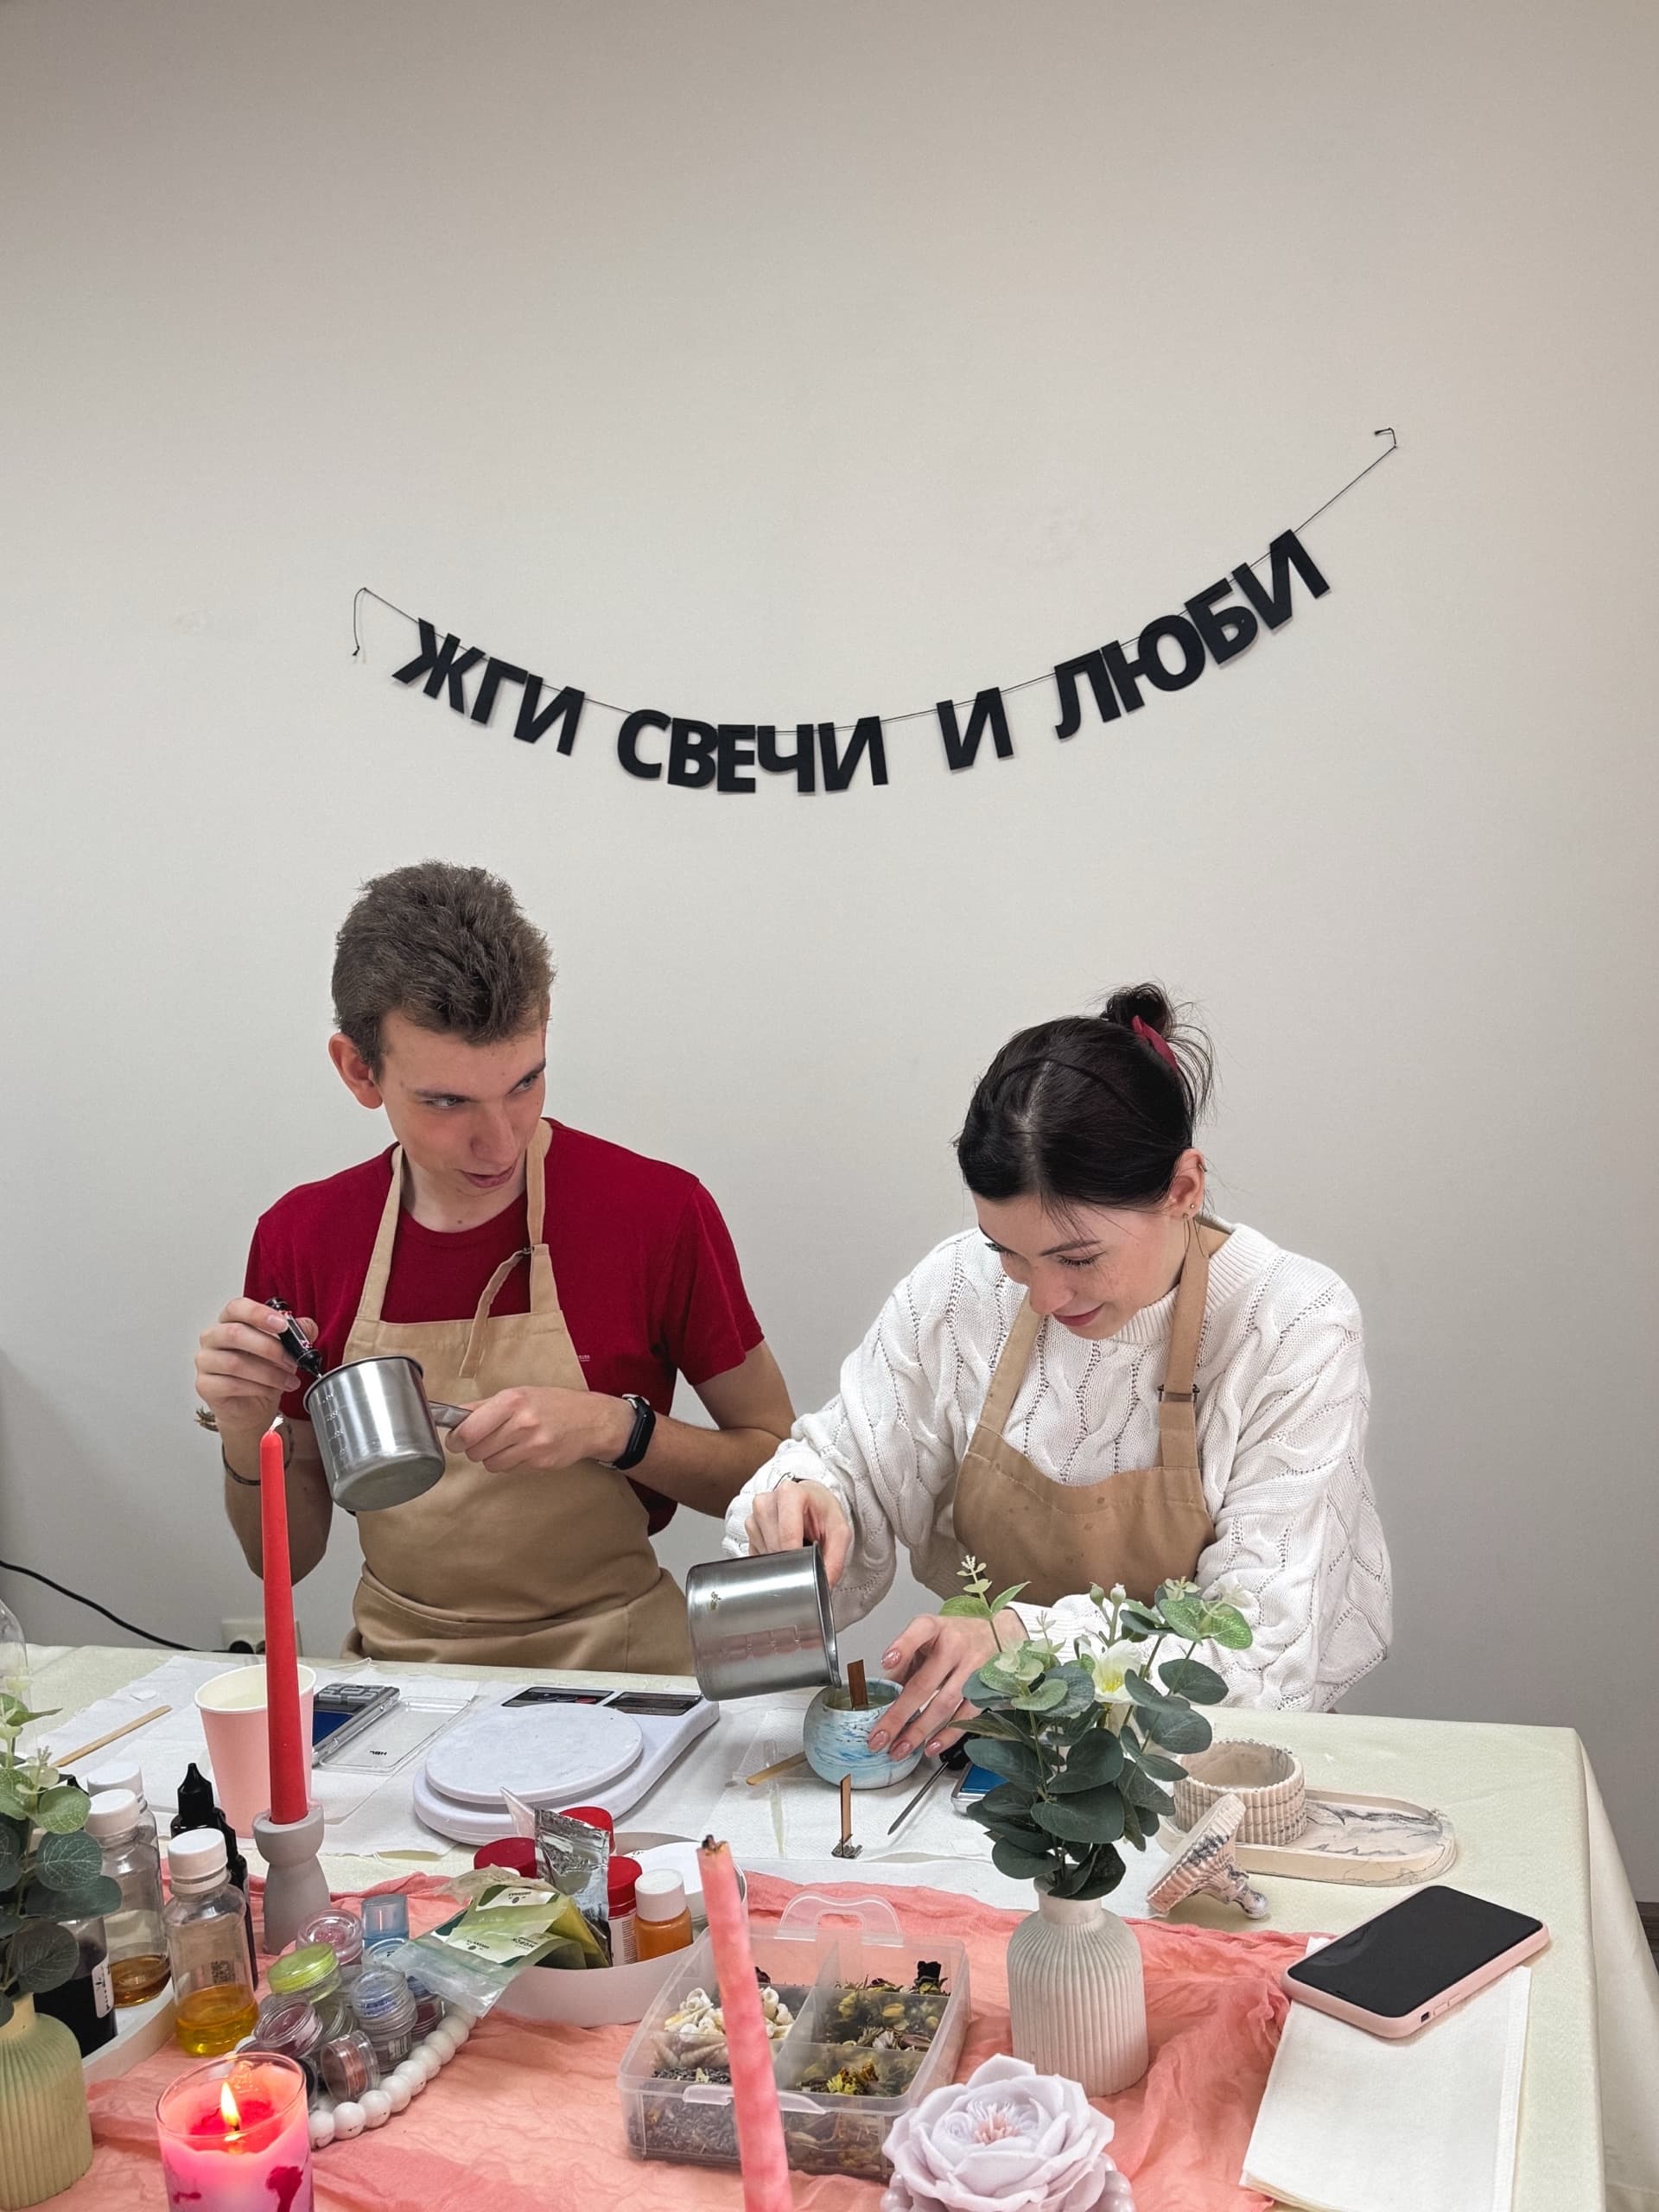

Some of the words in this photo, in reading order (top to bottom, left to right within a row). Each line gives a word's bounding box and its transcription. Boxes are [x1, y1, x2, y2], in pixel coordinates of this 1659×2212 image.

[391, 617, 586, 757] ЖГИ
[617, 709, 888, 793] СВЕЧИ
[936, 687, 1014, 771] И
[1054, 529, 1330, 740] ЛЮБИ
